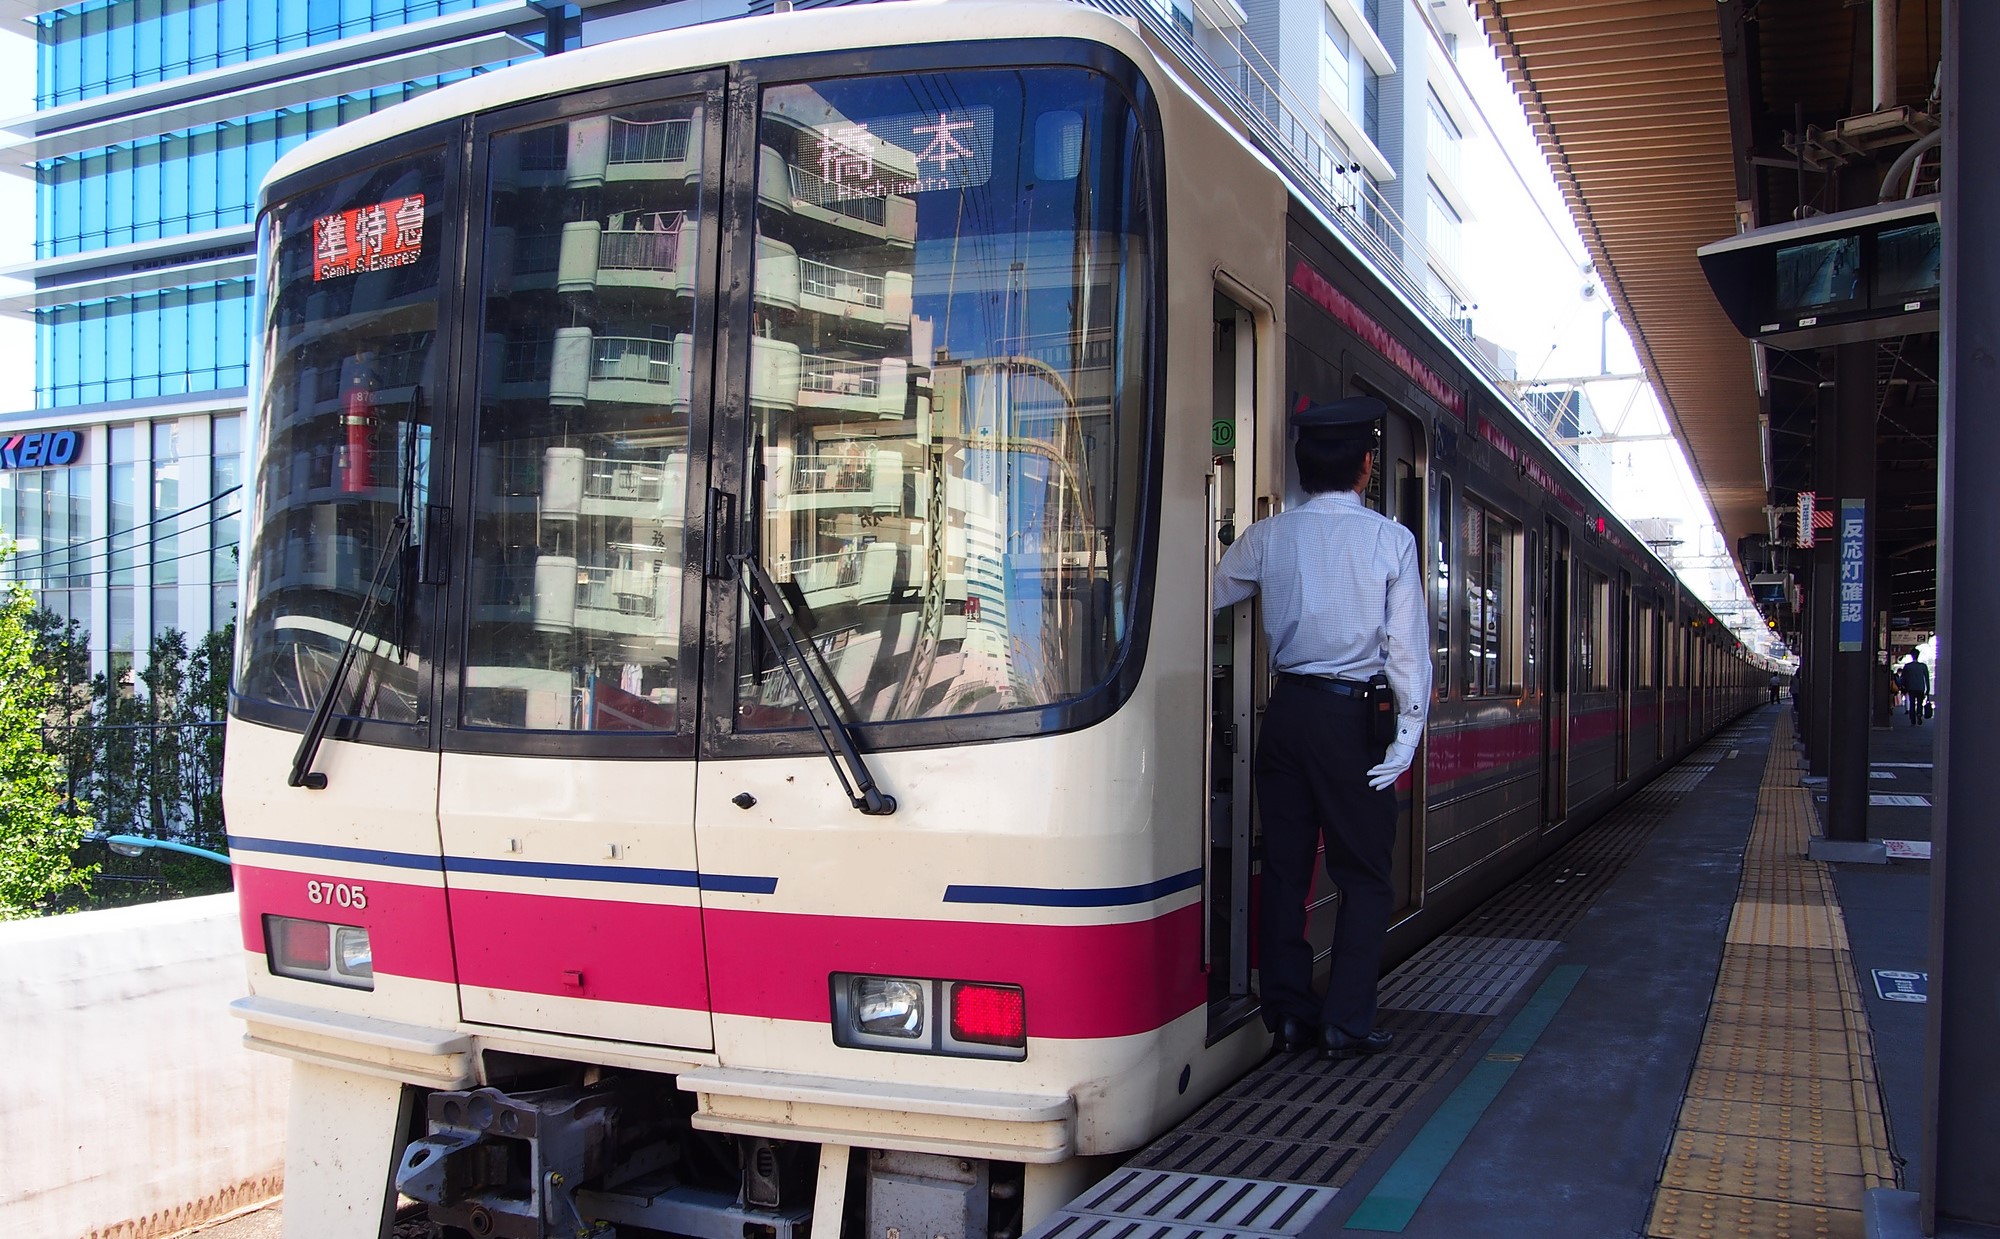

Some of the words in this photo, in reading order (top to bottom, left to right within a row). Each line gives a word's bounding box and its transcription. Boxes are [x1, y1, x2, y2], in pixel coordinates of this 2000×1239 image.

[816, 112, 974, 184] 橋本
[318, 197, 424, 263] 準特急
[0, 430, 77, 469] KEIO
[1213, 426, 1230, 441] 10
[1841, 519, 1863, 623] 反応灯確認
[307, 880, 367, 909] 8705
